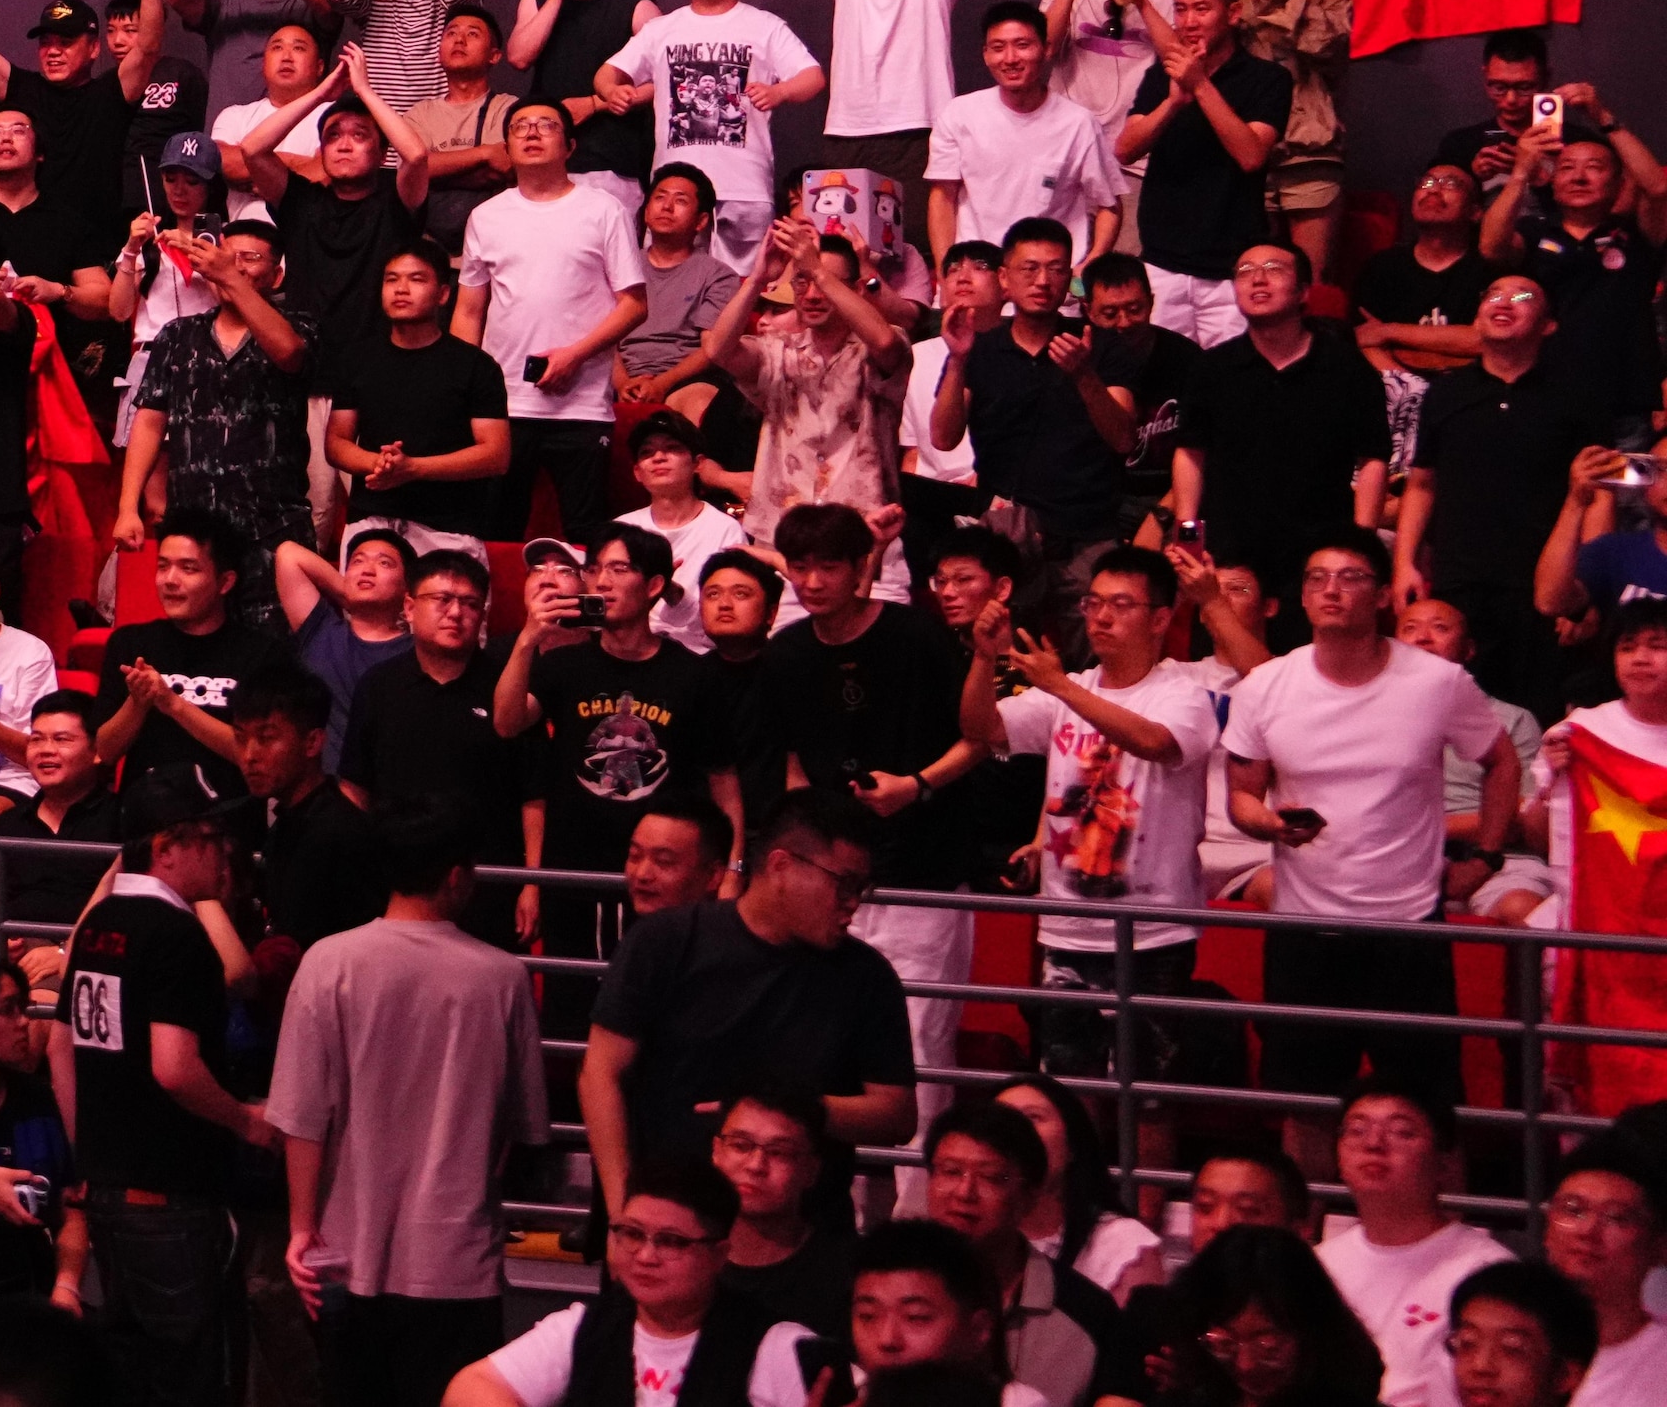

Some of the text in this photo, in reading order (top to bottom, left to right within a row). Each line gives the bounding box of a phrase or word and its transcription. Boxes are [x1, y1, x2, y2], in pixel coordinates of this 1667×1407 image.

[666, 43, 752, 63] MING YANG
[141, 82, 178, 109] 23
[182, 138, 199, 156] NY
